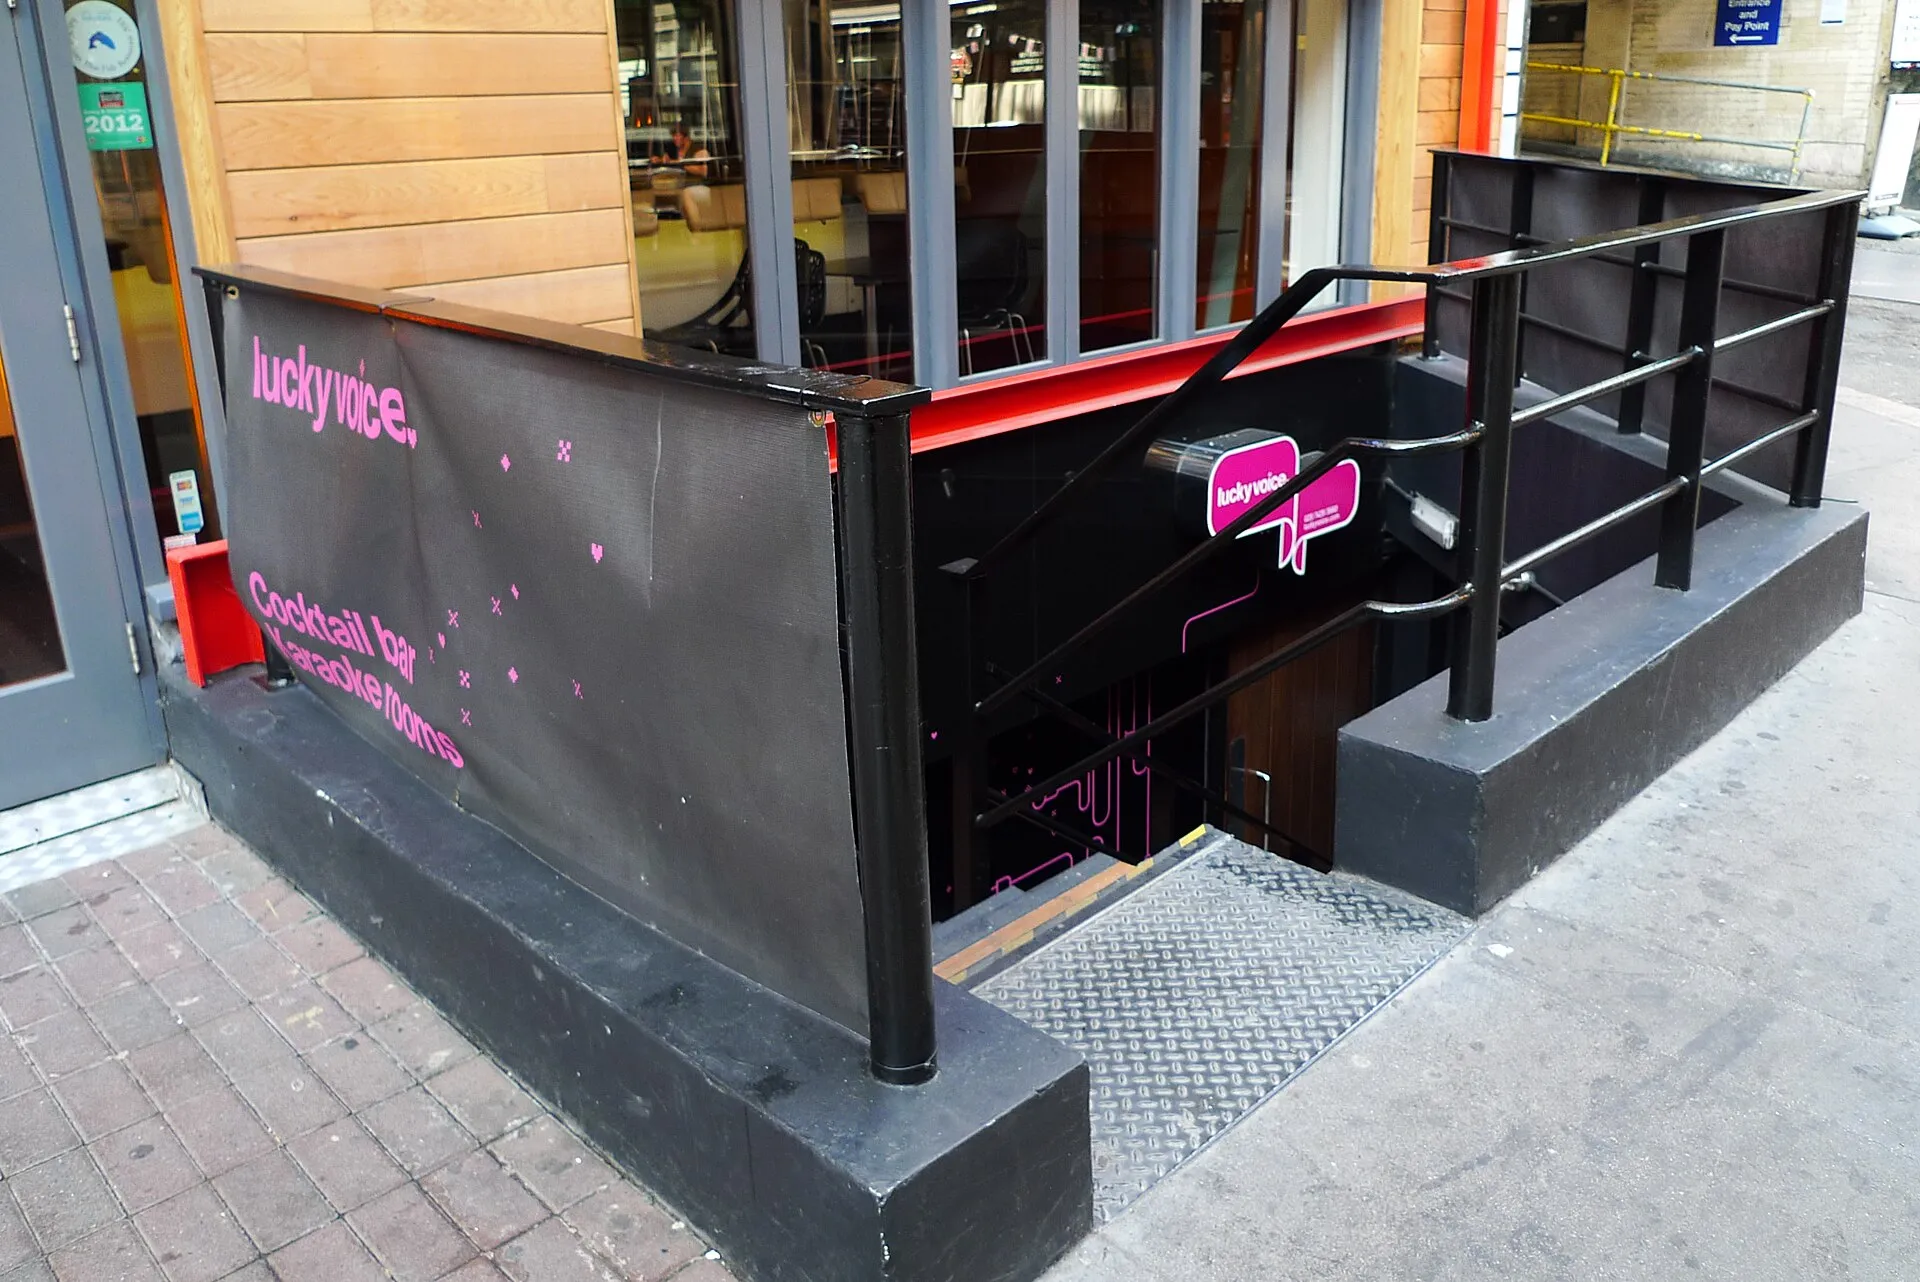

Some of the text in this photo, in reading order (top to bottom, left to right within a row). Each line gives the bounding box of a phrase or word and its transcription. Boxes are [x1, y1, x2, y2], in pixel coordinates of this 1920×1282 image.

[1724, 21, 1769, 33] Pay Point
[1738, 10, 1758, 19] and
[85, 114, 144, 133] 2012
[253, 335, 333, 433] lucky
[1217, 481, 1253, 508] lucky
[249, 571, 416, 685] Cocktail bar
[265, 622, 464, 769] Karaoke rooms
